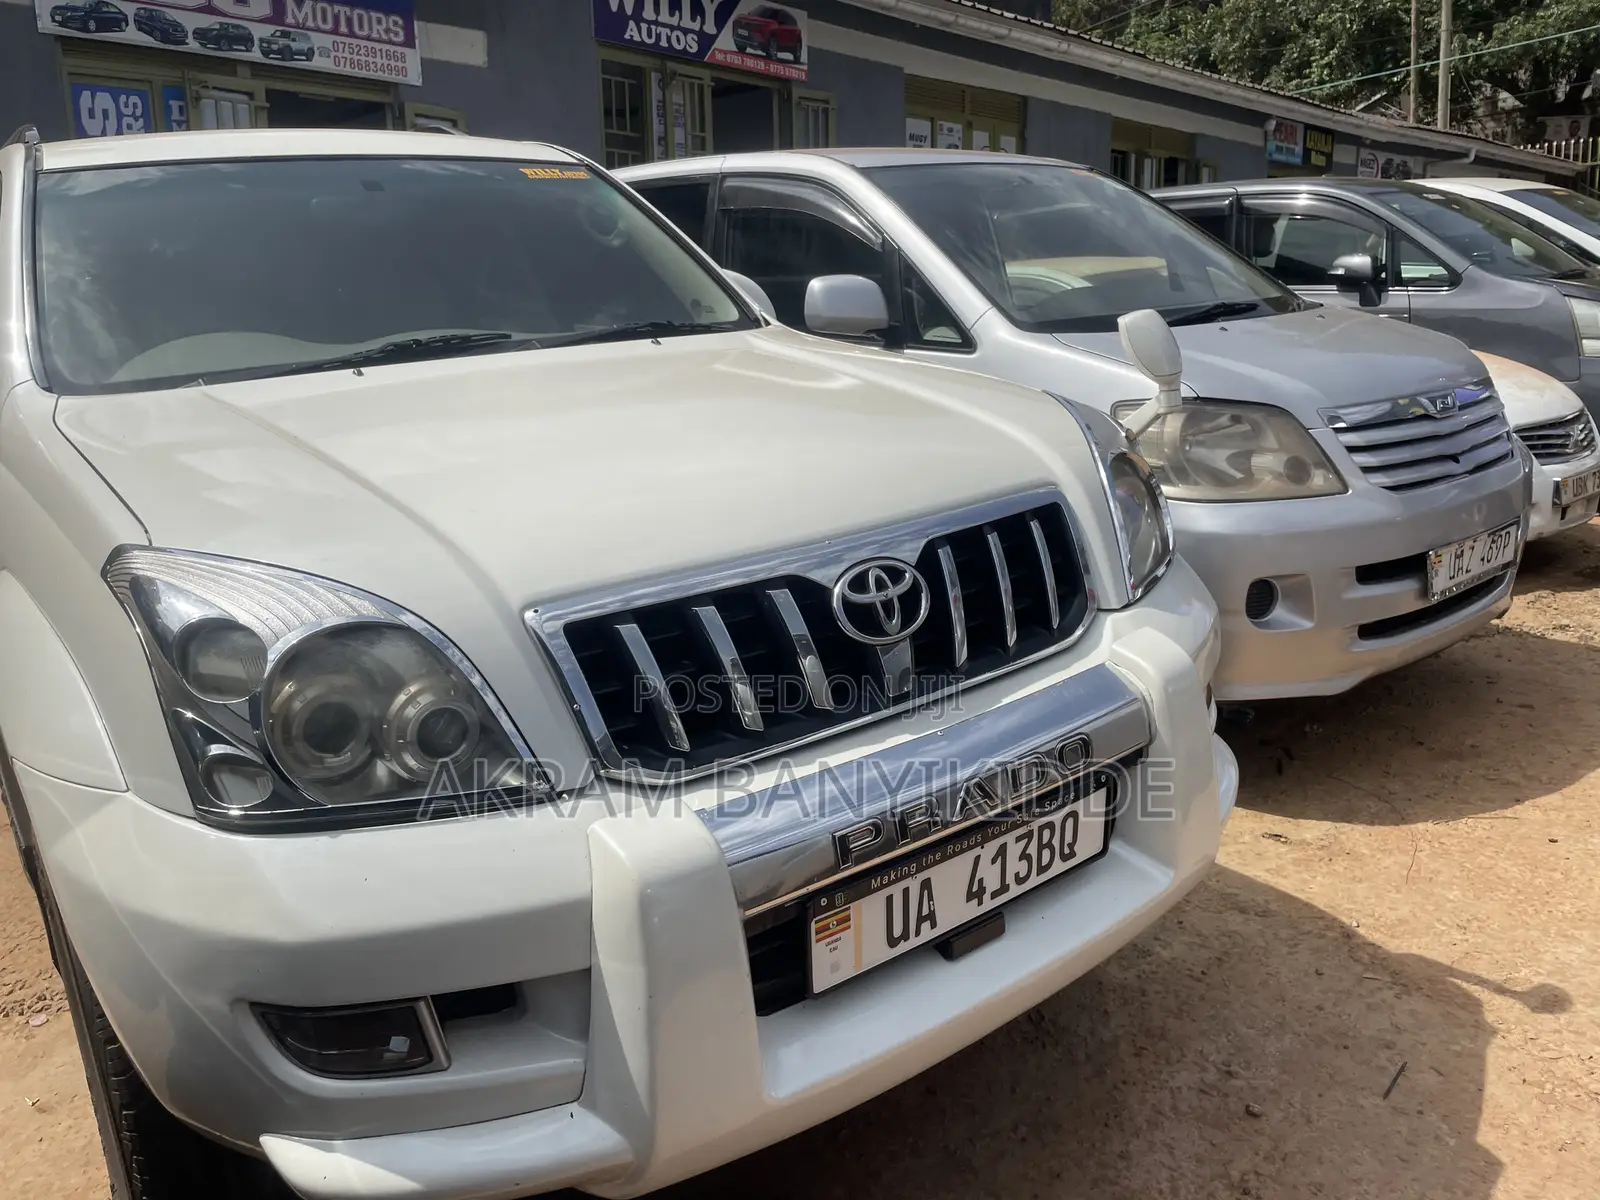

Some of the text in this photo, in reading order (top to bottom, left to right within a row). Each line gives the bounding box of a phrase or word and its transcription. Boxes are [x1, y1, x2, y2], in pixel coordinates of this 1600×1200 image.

[284, 1, 405, 43] MOTORS
[623, 20, 699, 53] AUTOS
[332, 40, 407, 64] 0752391668
[333, 55, 408, 78] 0786834990
[831, 732, 1093, 870] PRADO
[871, 791, 1076, 889] Making the Roads Your Safe Space
[885, 810, 1080, 949] UA 413BQ
